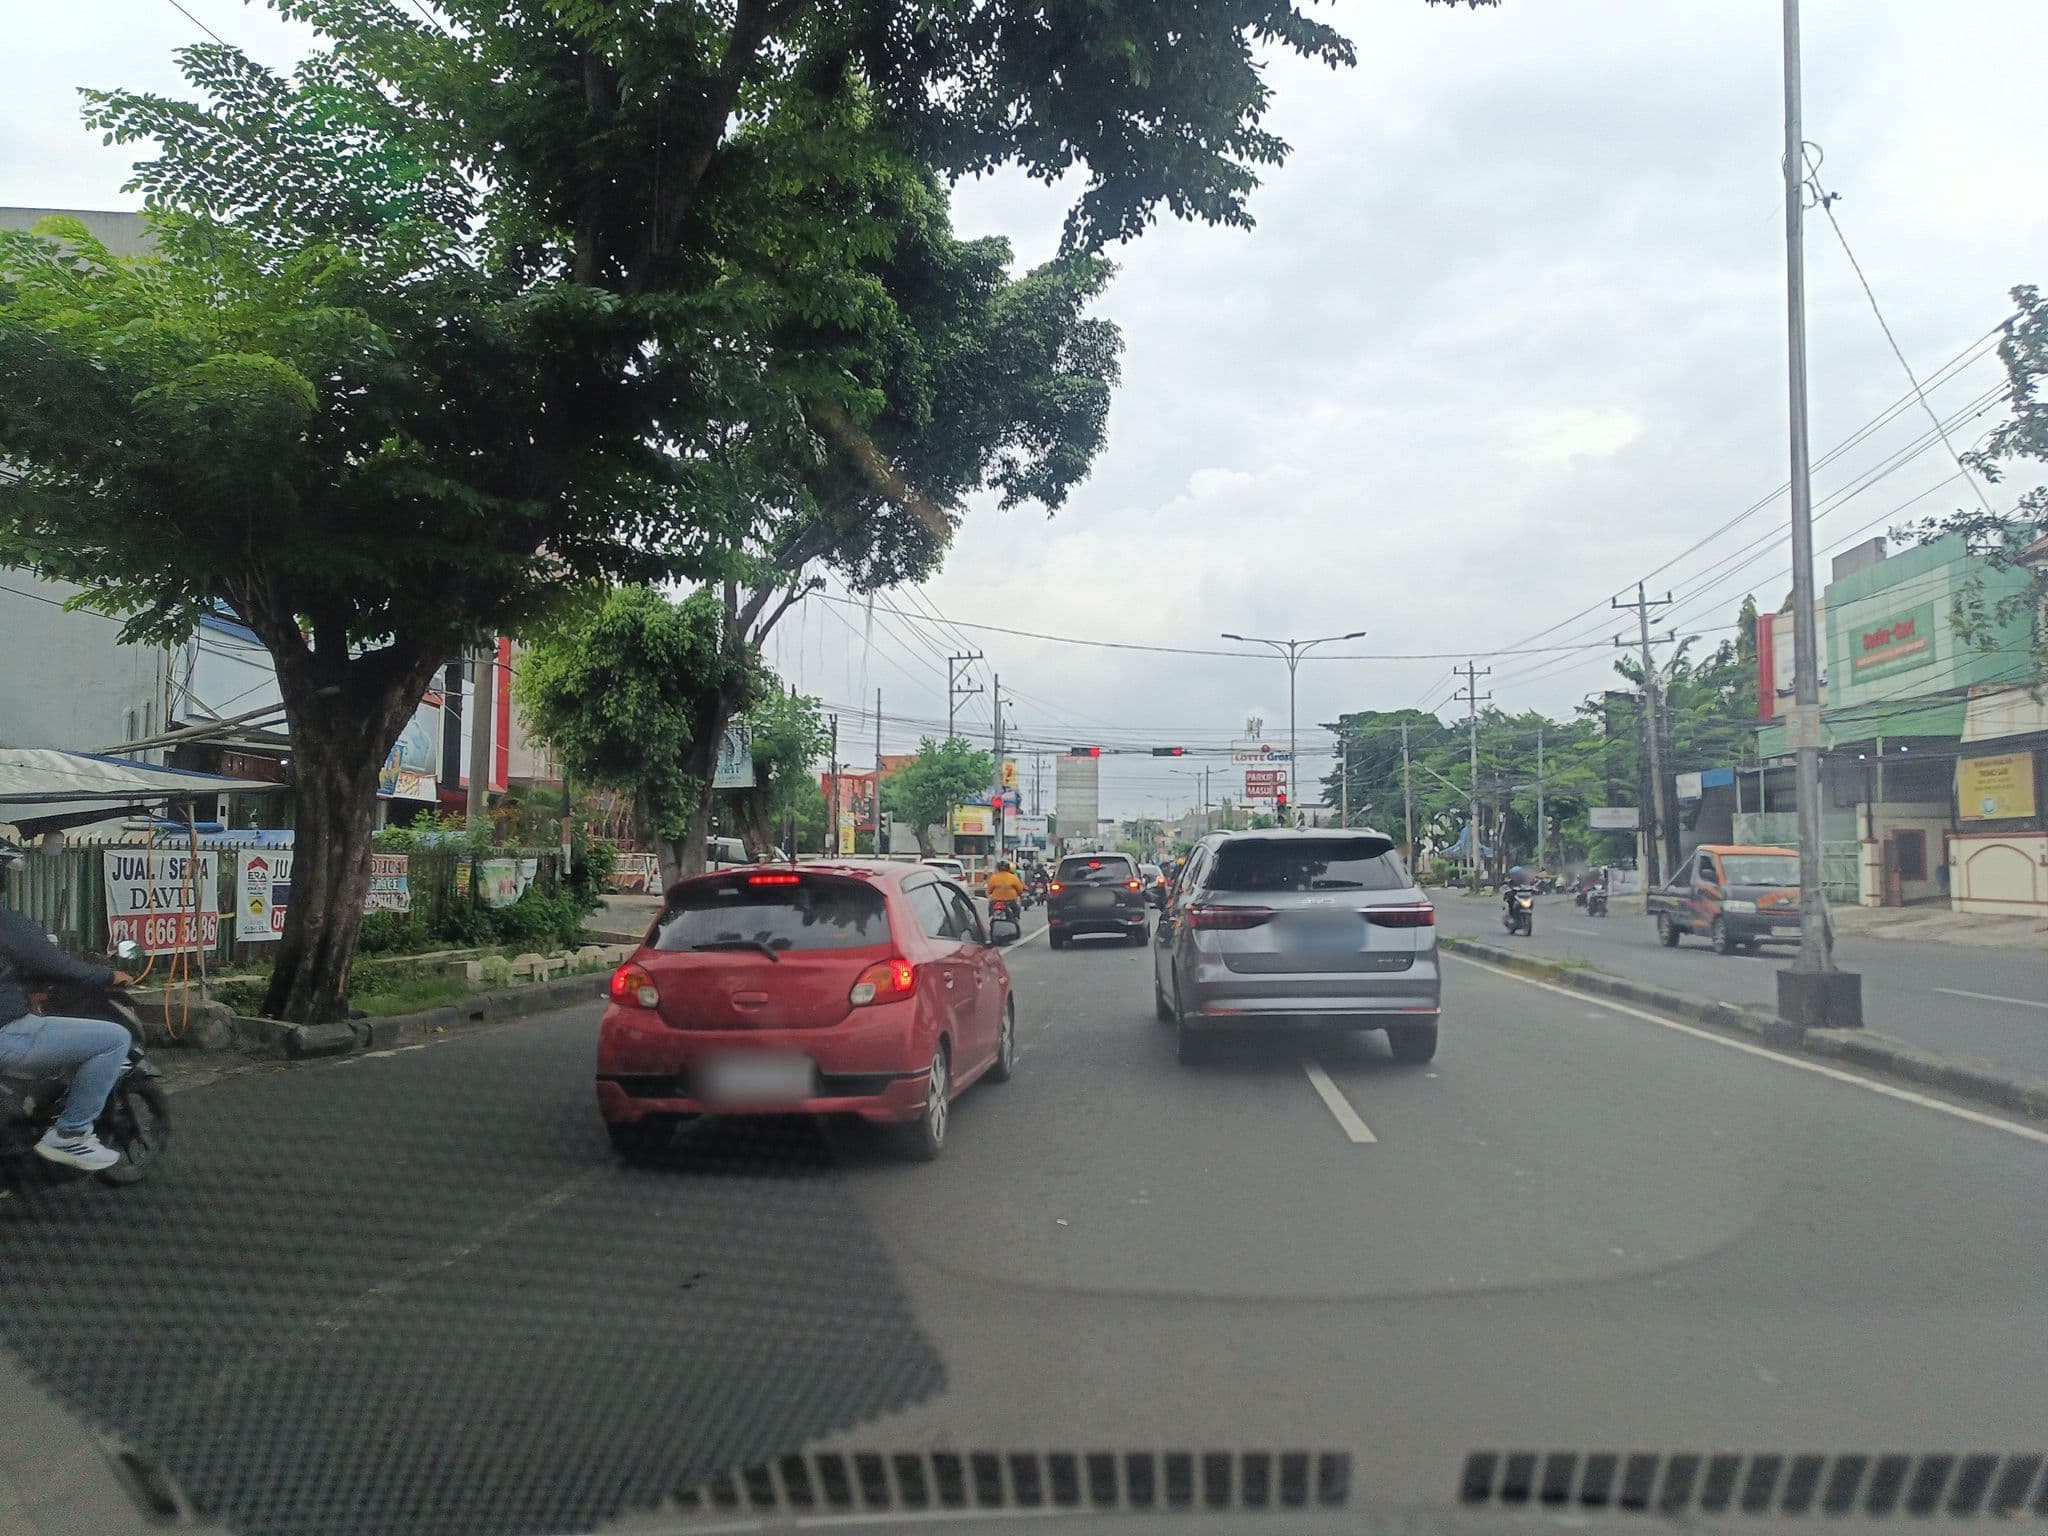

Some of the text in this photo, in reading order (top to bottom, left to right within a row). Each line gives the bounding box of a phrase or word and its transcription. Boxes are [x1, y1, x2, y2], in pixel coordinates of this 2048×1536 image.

[112, 857, 155, 880] JUAL
[169, 857, 208, 880] SEA
[248, 871, 267, 880] ERA
[130, 887, 197, 909] DAVID
[145, 917, 177, 946] 666
